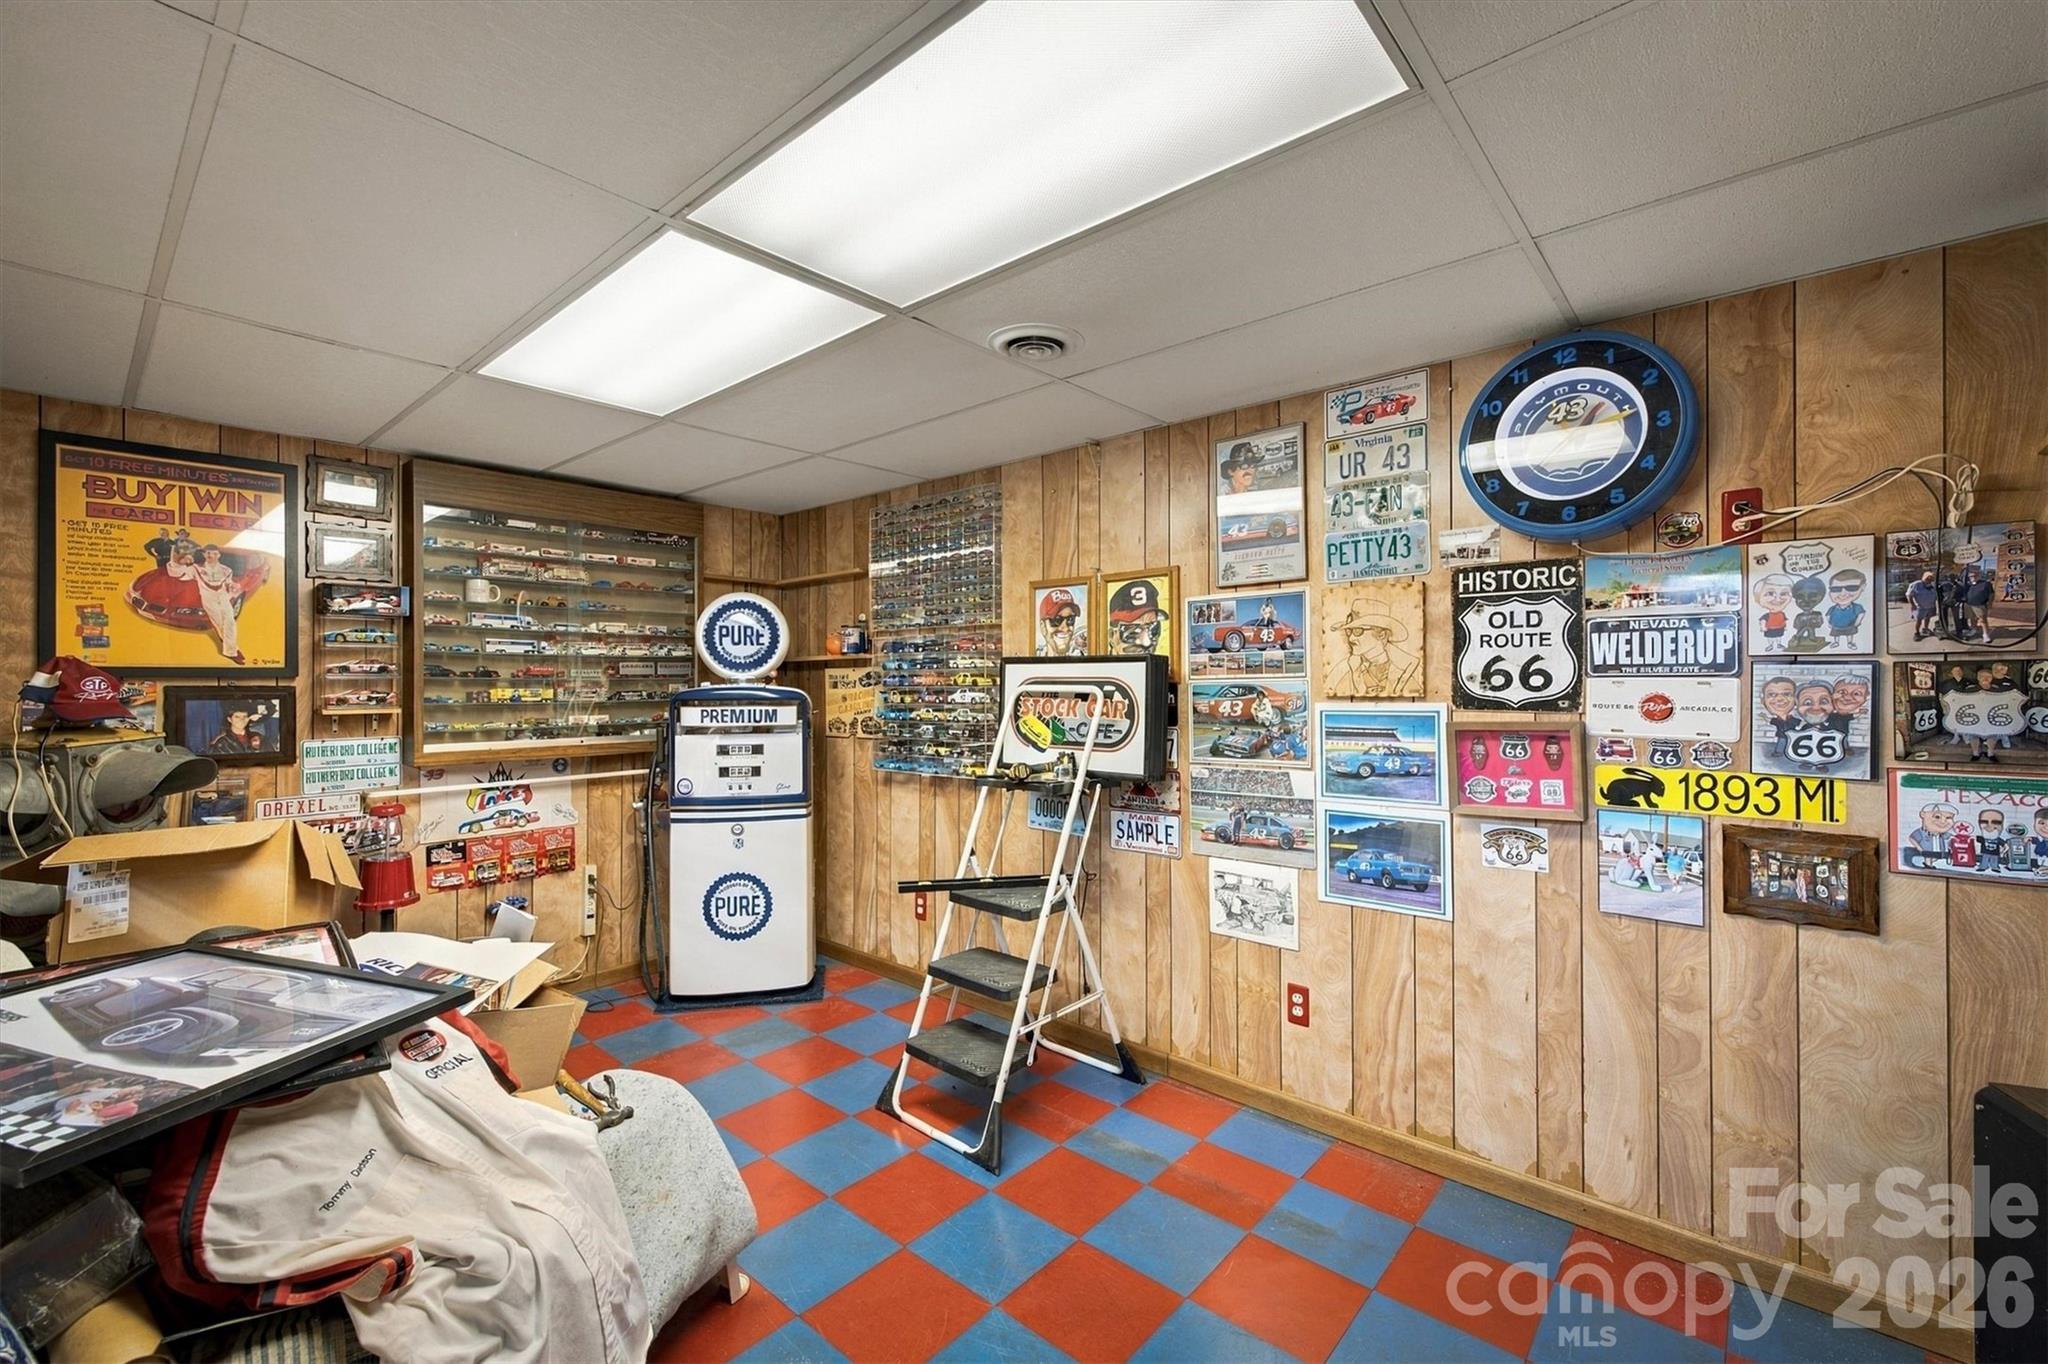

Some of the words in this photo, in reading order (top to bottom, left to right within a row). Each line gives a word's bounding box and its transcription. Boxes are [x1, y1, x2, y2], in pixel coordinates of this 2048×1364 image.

[1552, 347, 1577, 365] 12
[1603, 348, 1616, 364] 1
[1510, 368, 1529, 385] 11
[1641, 368, 1659, 386] 2
[1480, 400, 1503, 418] 10
[1513, 383, 1635, 434] PLYMOUTH
[1548, 395, 1588, 424] 43
[1655, 410, 1673, 427] 3
[1355, 434, 1393, 448] Virginia
[88, 454, 106, 468] 10
[109, 458, 154, 474] FREE
[158, 466, 230, 483] MINUTES
[1340, 451, 1367, 479] UR
[1382, 443, 1411, 471] 43
[1640, 453, 1656, 471] 4
[1484, 479, 1501, 494] 8
[83, 474, 176, 505] BUY
[189, 486, 263, 518] WIN
[1609, 488, 1626, 504] 5
[112, 506, 169, 521] CARD
[1516, 500, 1530, 516] 7
[1561, 505, 1577, 522] 6
[1227, 523, 1249, 537] 43
[1327, 533, 1412, 568] PETTY43
[1458, 564, 1577, 593] HISTORIC
[1130, 586, 1148, 607] 3
[1488, 609, 1544, 629] OLD
[1629, 619, 1690, 630] NEVADA
[719, 625, 766, 647] PURE
[1260, 628, 1276, 643] 43
[1480, 632, 1553, 649] ROUTE
[1591, 628, 1734, 666] WELDERUP
[1480, 654, 1554, 693] 66
[1621, 666, 1638, 674] THE
[1640, 666, 1670, 674] SILVER
[1672, 665, 1700, 673] STATE
[85, 679, 108, 690] STP
[700, 708, 779, 724] PREMIUM
[1020, 697, 1081, 719] STOCK
[1086, 696, 1130, 720] CAR
[1218, 700, 1244, 717] 43
[1955, 703, 2014, 727] 66
[1918, 712, 1935, 728] 66
[1076, 721, 1115, 740] CFE
[356, 742, 388, 756] COLLEGE
[388, 741, 398, 754] NC
[1505, 744, 1525, 757] 66
[1791, 734, 1838, 758] 66
[1384, 756, 1400, 770] 43
[1653, 752, 1677, 765] 66
[356, 766, 387, 780] COLLEGE
[388, 765, 398, 777] NC
[1678, 771, 1781, 818] 1893
[263, 798, 327, 818] DREXEL
[1128, 813, 1161, 823] MAINE
[1116, 819, 1175, 846] SAMPLE
[1249, 827, 1267, 840] 43
[1505, 850, 1523, 861] 66
[715, 895, 760, 918] PURE
[425, 1053, 474, 1080] OFFICIAL
[319, 1180, 352, 1212] Tommy
